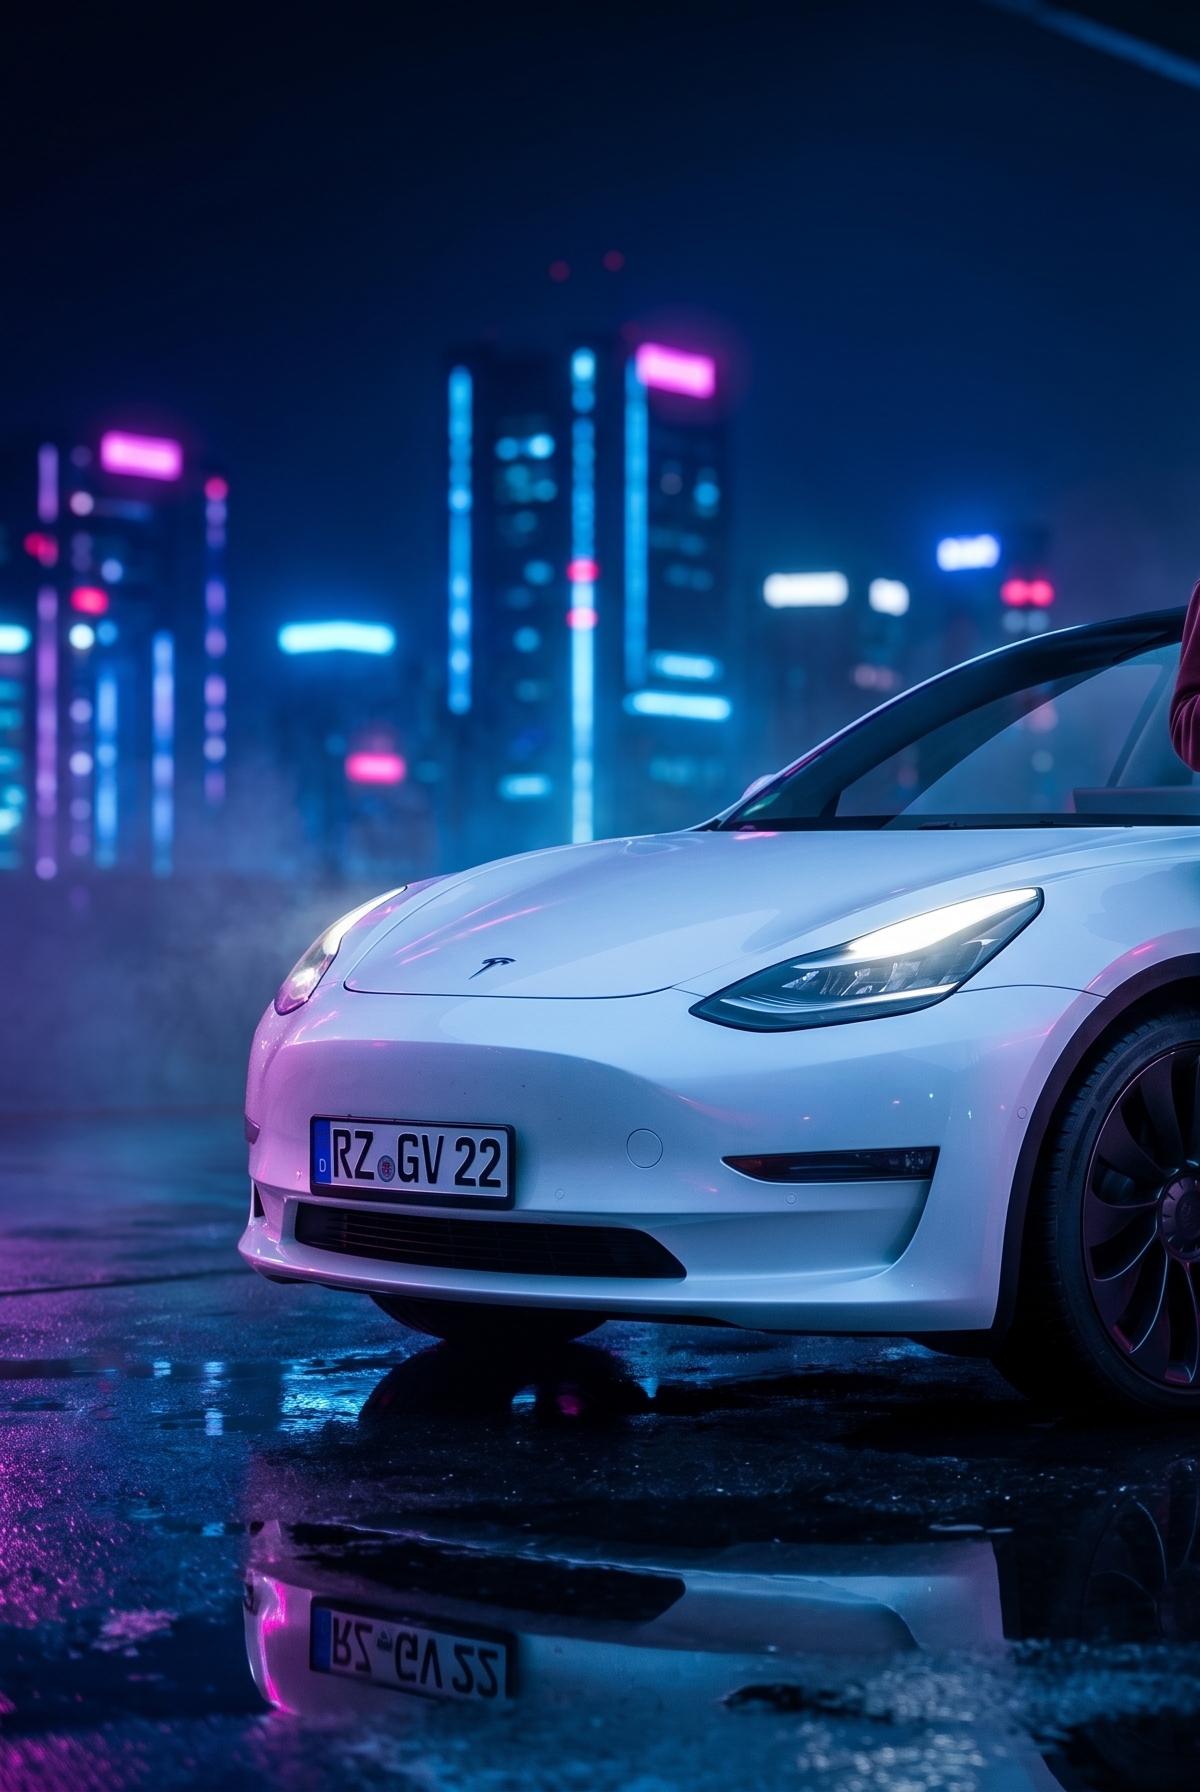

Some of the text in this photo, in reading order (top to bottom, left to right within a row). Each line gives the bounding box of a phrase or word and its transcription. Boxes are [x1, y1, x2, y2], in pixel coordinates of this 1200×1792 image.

[319, 1158, 327, 1173] D
[333, 1128, 501, 1188] RZ GV 22
